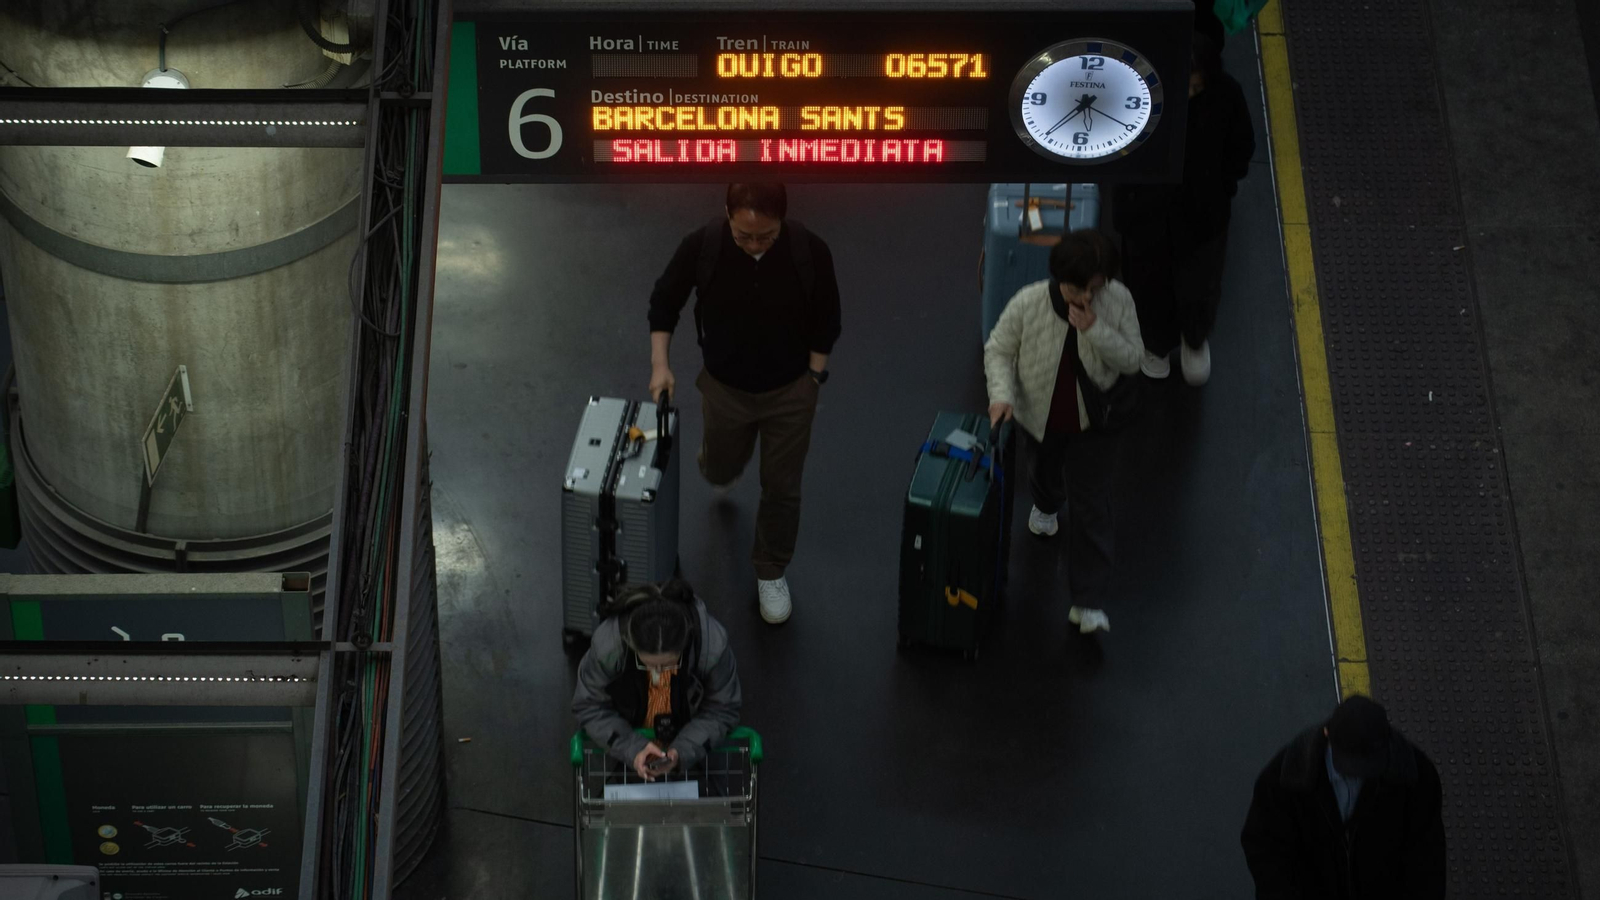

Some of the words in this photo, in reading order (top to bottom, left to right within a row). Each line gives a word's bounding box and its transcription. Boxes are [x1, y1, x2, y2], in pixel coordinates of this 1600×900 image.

[498, 34, 530, 51] Vía
[589, 35, 635, 51] Hora
[646, 39, 680, 51] TIME
[716, 35, 759, 51] Tren
[770, 39, 810, 51] TRAIN
[499, 58, 568, 69] PLATFORM
[717, 53, 823, 79] OUIGO
[885, 52, 988, 78] 06571
[1079, 56, 1105, 70] 12
[1069, 81, 1106, 89] FESTINA
[590, 89, 664, 105] Destino
[675, 93, 759, 104] DESTINATION
[1030, 92, 1047, 106] 9
[1125, 96, 1141, 110] 3
[507, 87, 563, 160] 6
[592, 106, 780, 131] BARCELONA
[800, 106, 906, 130] SANTS
[1072, 132, 1089, 145] 6
[612, 138, 737, 164] SALIDA
[761, 139, 945, 163] INMEDIATA
[250, 887, 284, 896] adif
